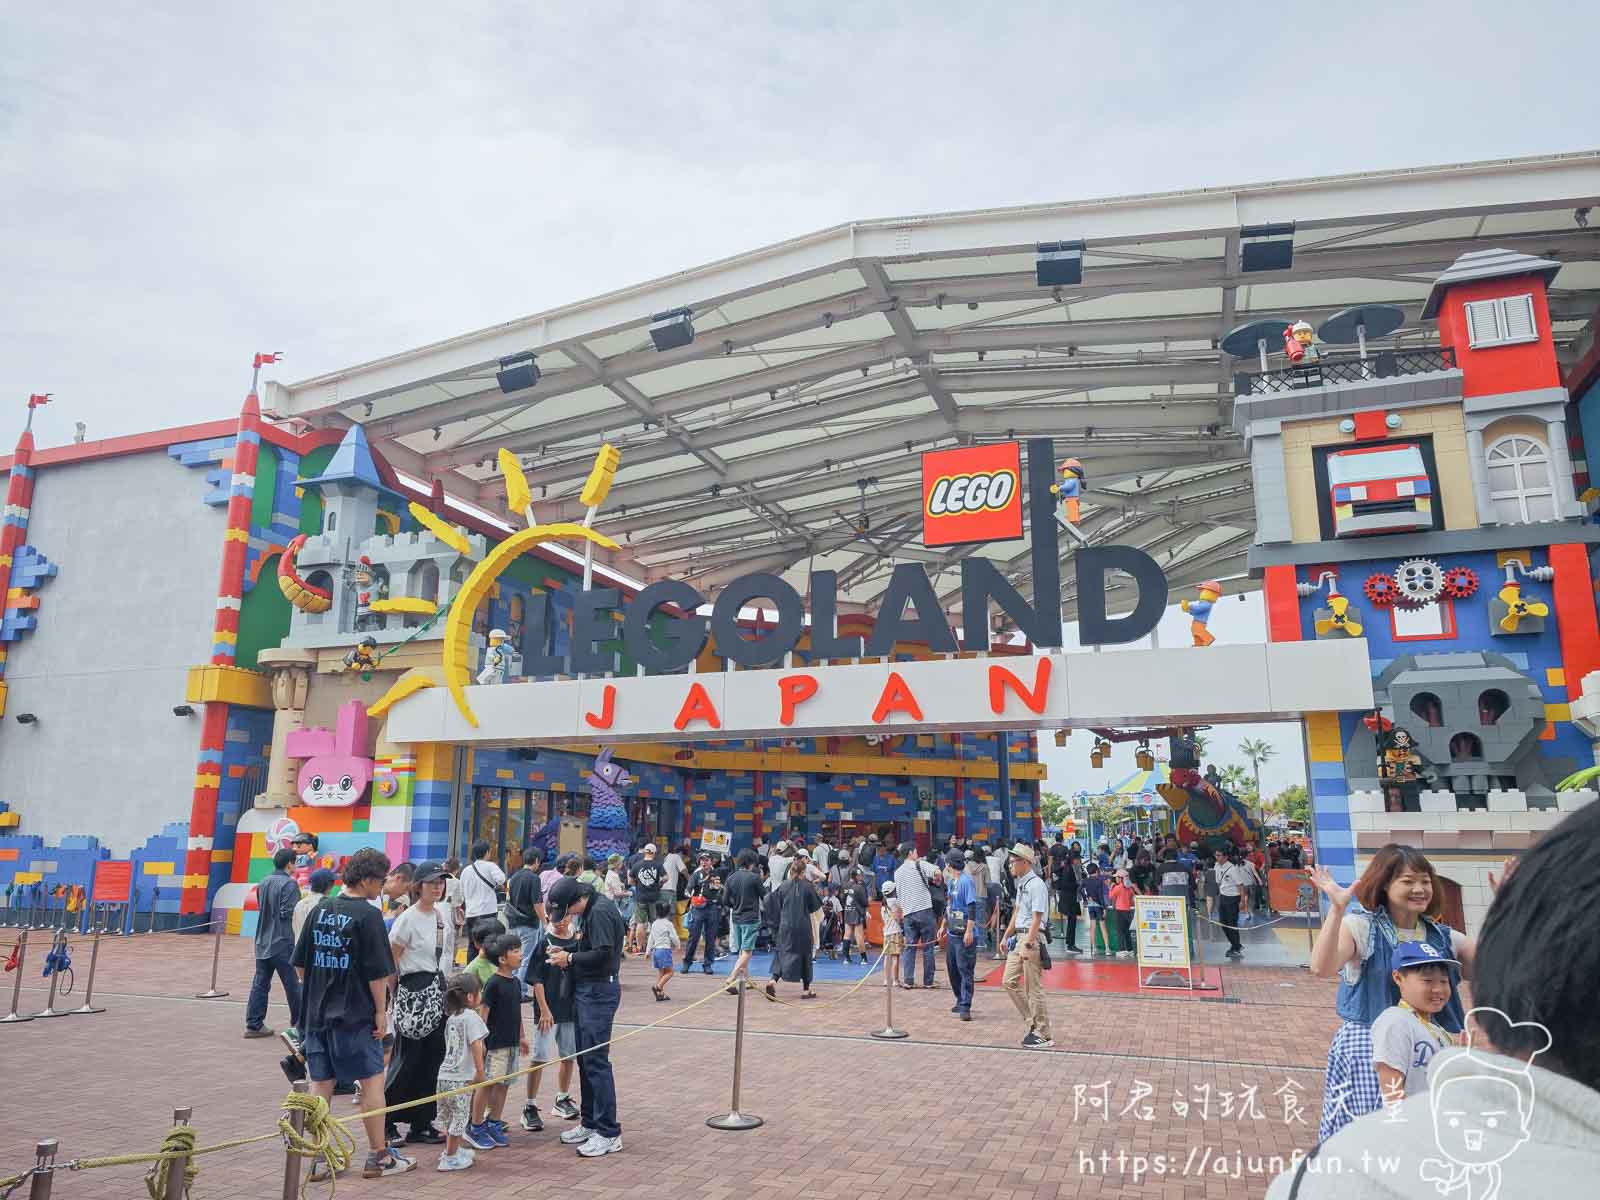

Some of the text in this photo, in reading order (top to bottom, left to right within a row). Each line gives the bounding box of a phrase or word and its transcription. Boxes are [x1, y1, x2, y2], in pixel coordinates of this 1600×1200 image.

[929, 471, 1014, 515] LEGO
[522, 438, 1169, 676] LEGOLAND
[585, 656, 1052, 731] JAPAN
[313, 949, 350, 969] Mind
[1412, 1040, 1435, 1067] D
